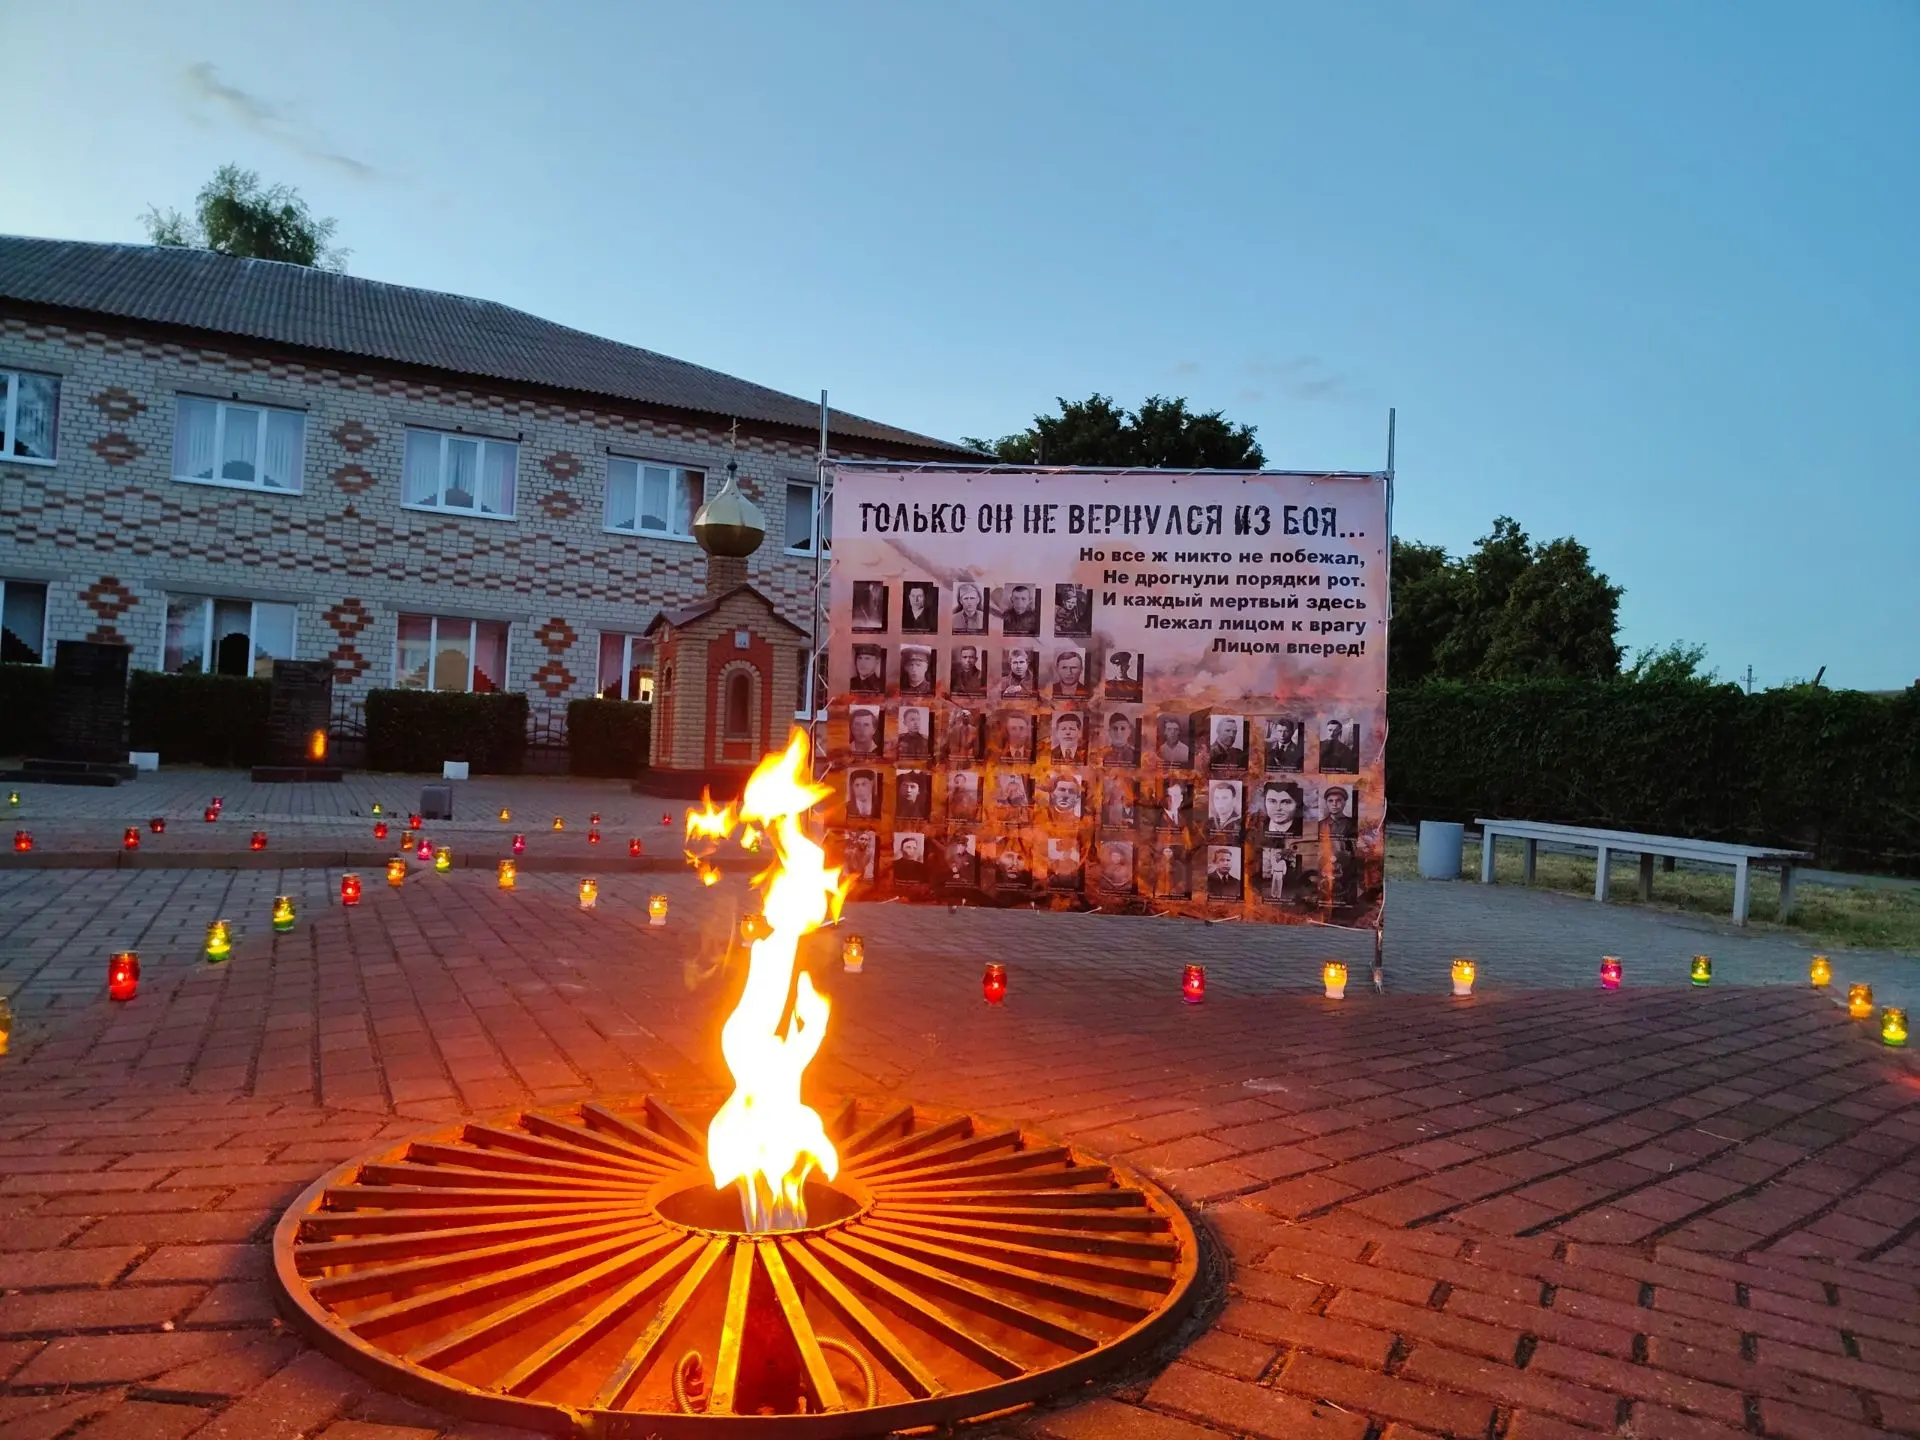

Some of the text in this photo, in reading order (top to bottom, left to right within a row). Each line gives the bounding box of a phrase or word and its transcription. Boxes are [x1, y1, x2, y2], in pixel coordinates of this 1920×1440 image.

[859, 503, 967, 533] ТОЛЬКО
[978, 503, 1013, 534] ОН
[1023, 503, 1059, 534] НЕ
[1068, 504, 1223, 536] ВЕРНУЛСЯ
[1234, 505, 1271, 536] ИЗ
[1079, 547, 1365, 568] Но все ж никто не побежал,
[1103, 570, 1366, 589] Не дрогнули порядки рот.
[1103, 592, 1366, 611] И каждый мертвый здесь
[1144, 615, 1366, 635] Лежал лицом к врагу
[1211, 639, 1366, 658] Лицом вперед!
